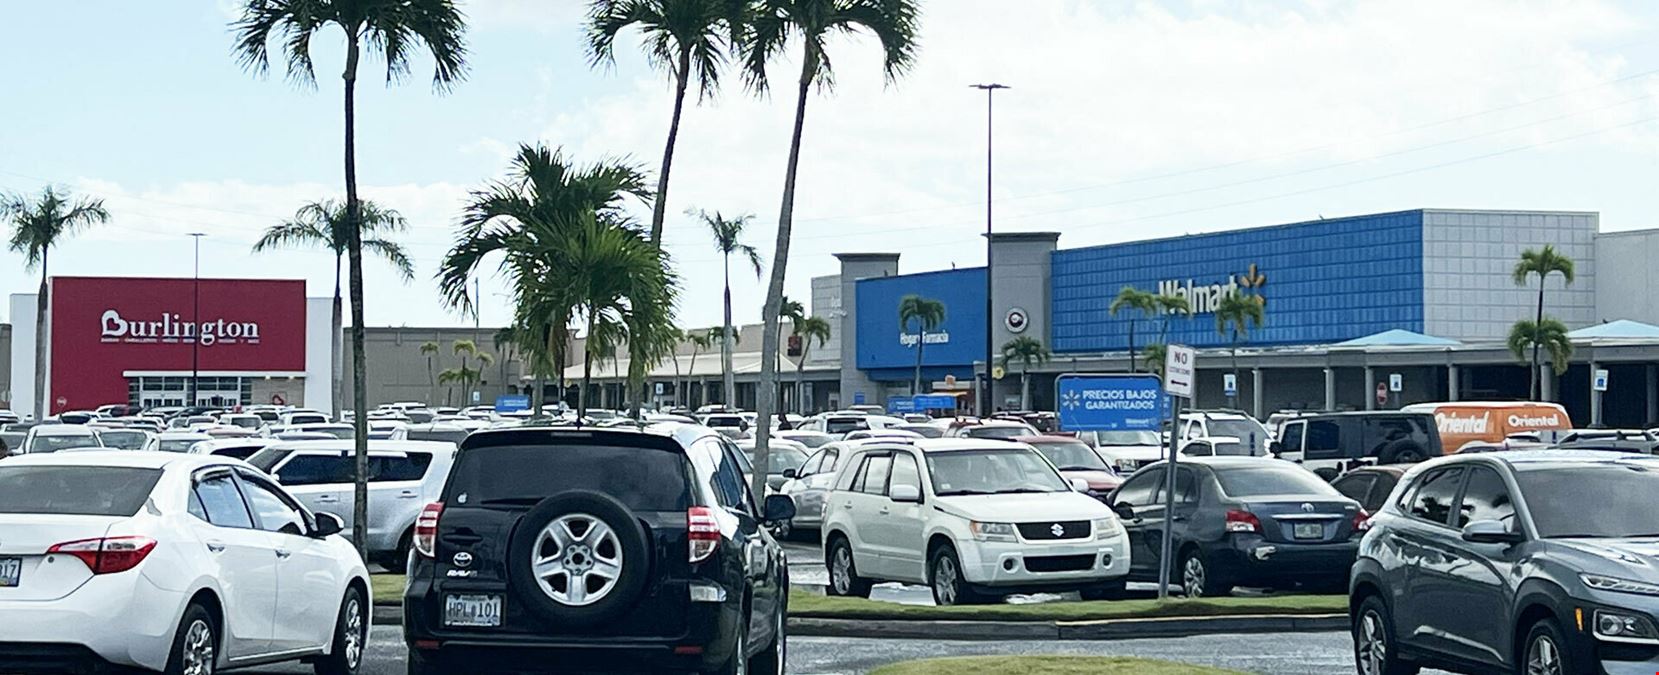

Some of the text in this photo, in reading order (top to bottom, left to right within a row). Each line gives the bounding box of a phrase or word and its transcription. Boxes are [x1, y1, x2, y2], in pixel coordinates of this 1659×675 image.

[1158, 275, 1238, 315] Walmart
[101, 309, 259, 346] Burlington
[1174, 351, 1188, 365] NO
[1082, 389, 1157, 400] PRECIOS BAJOS
[1085, 400, 1155, 410] GARANTIZADOS
[1435, 410, 1490, 433] Oriental
[1508, 414, 1559, 427] Oriental
[448, 602, 499, 617] HPL 101
